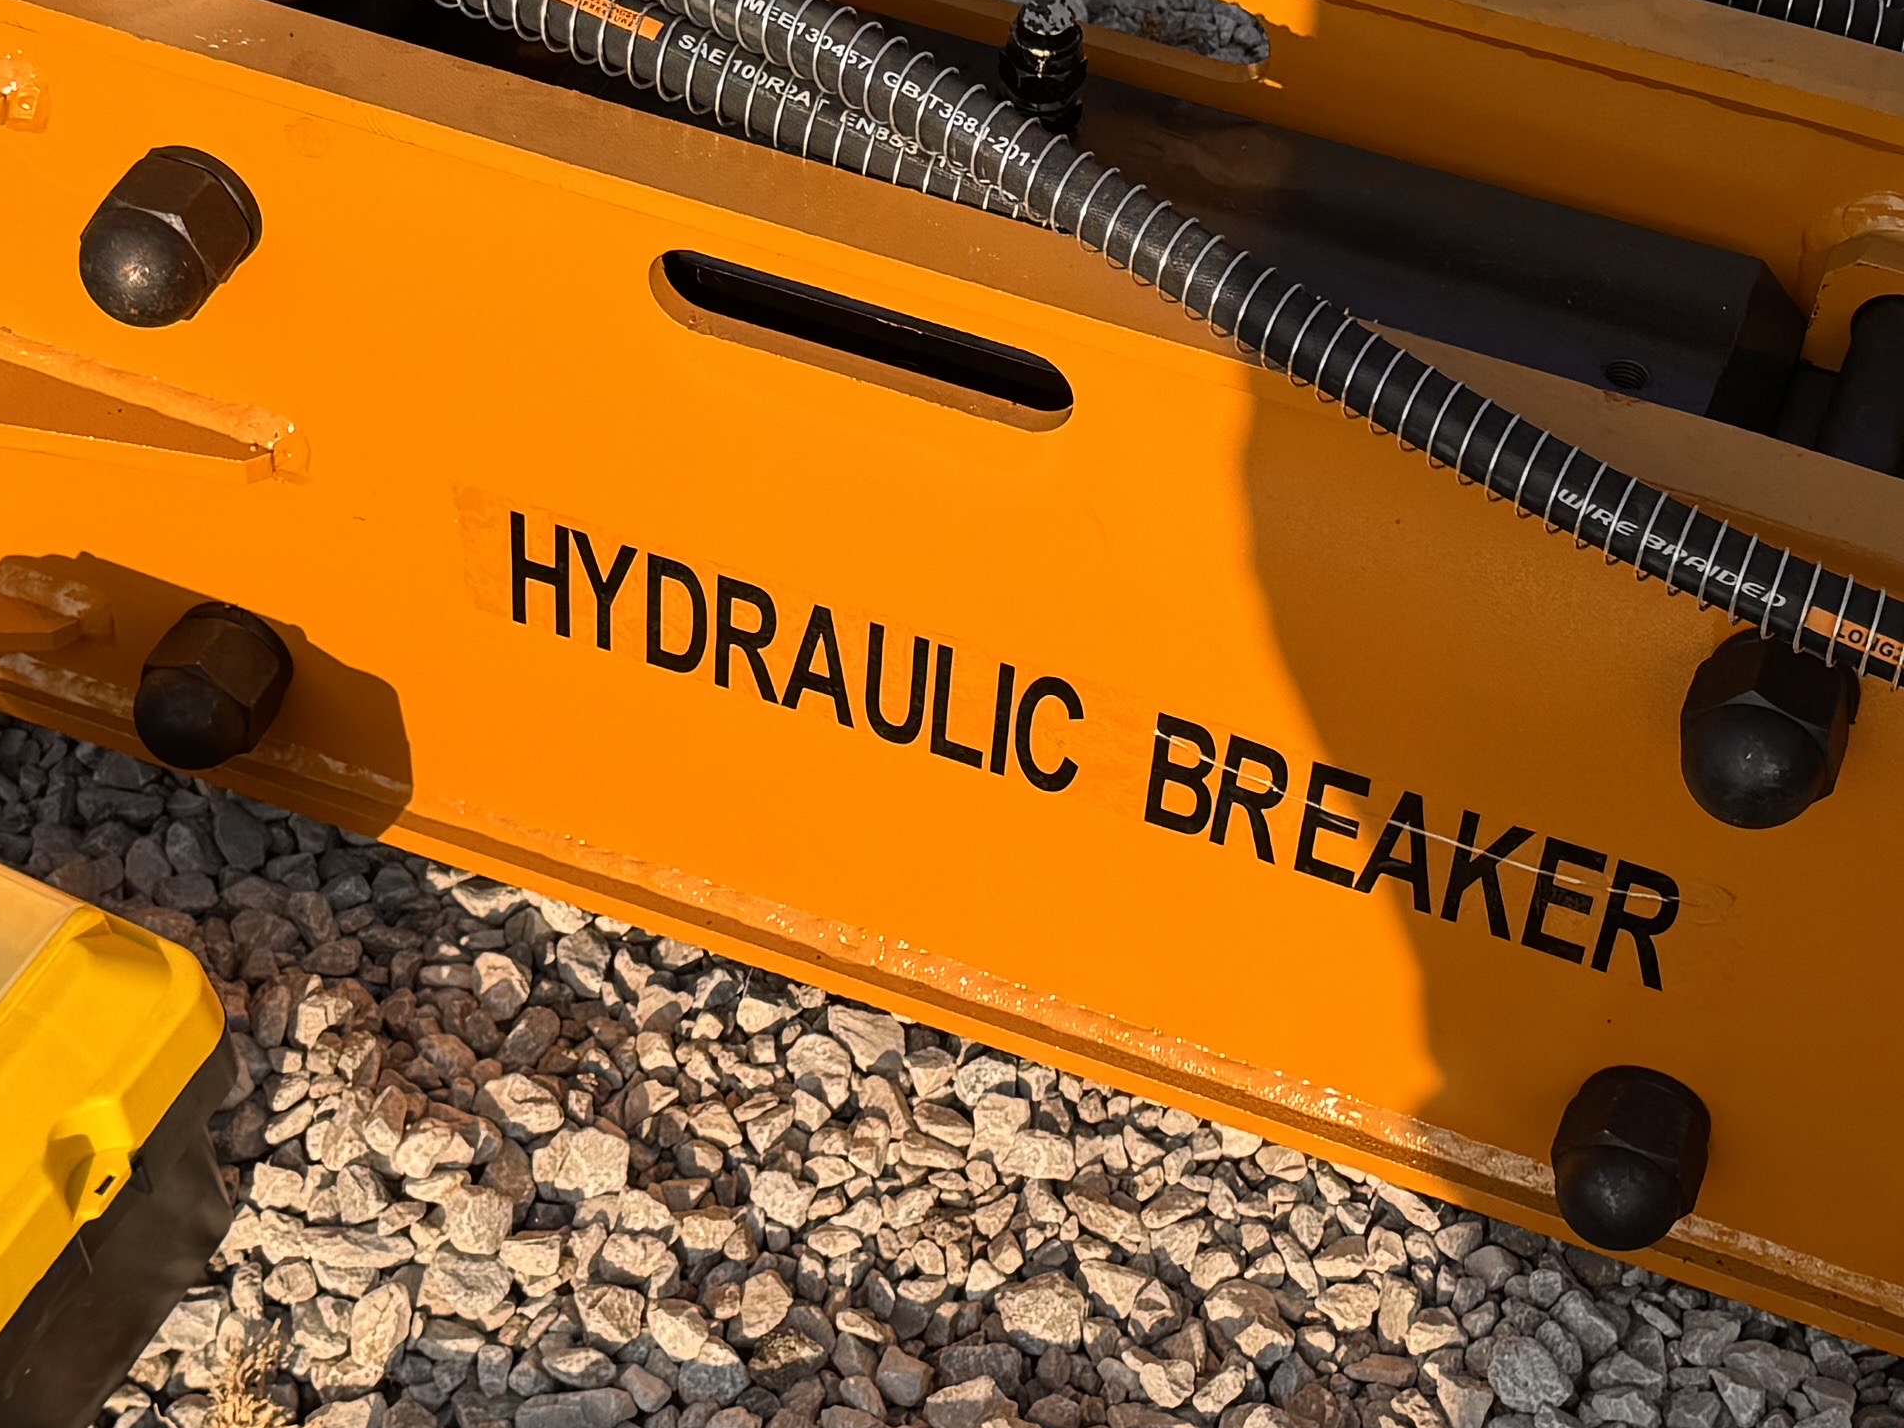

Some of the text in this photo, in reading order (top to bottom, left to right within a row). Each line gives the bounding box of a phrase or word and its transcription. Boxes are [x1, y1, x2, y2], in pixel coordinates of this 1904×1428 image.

[678, 33, 726, 66] SAE
[1556, 486, 1641, 536] WIRE
[1641, 532, 1787, 609] BRAIDED
[508, 510, 1682, 992] HYDRAULIC BREAKER
